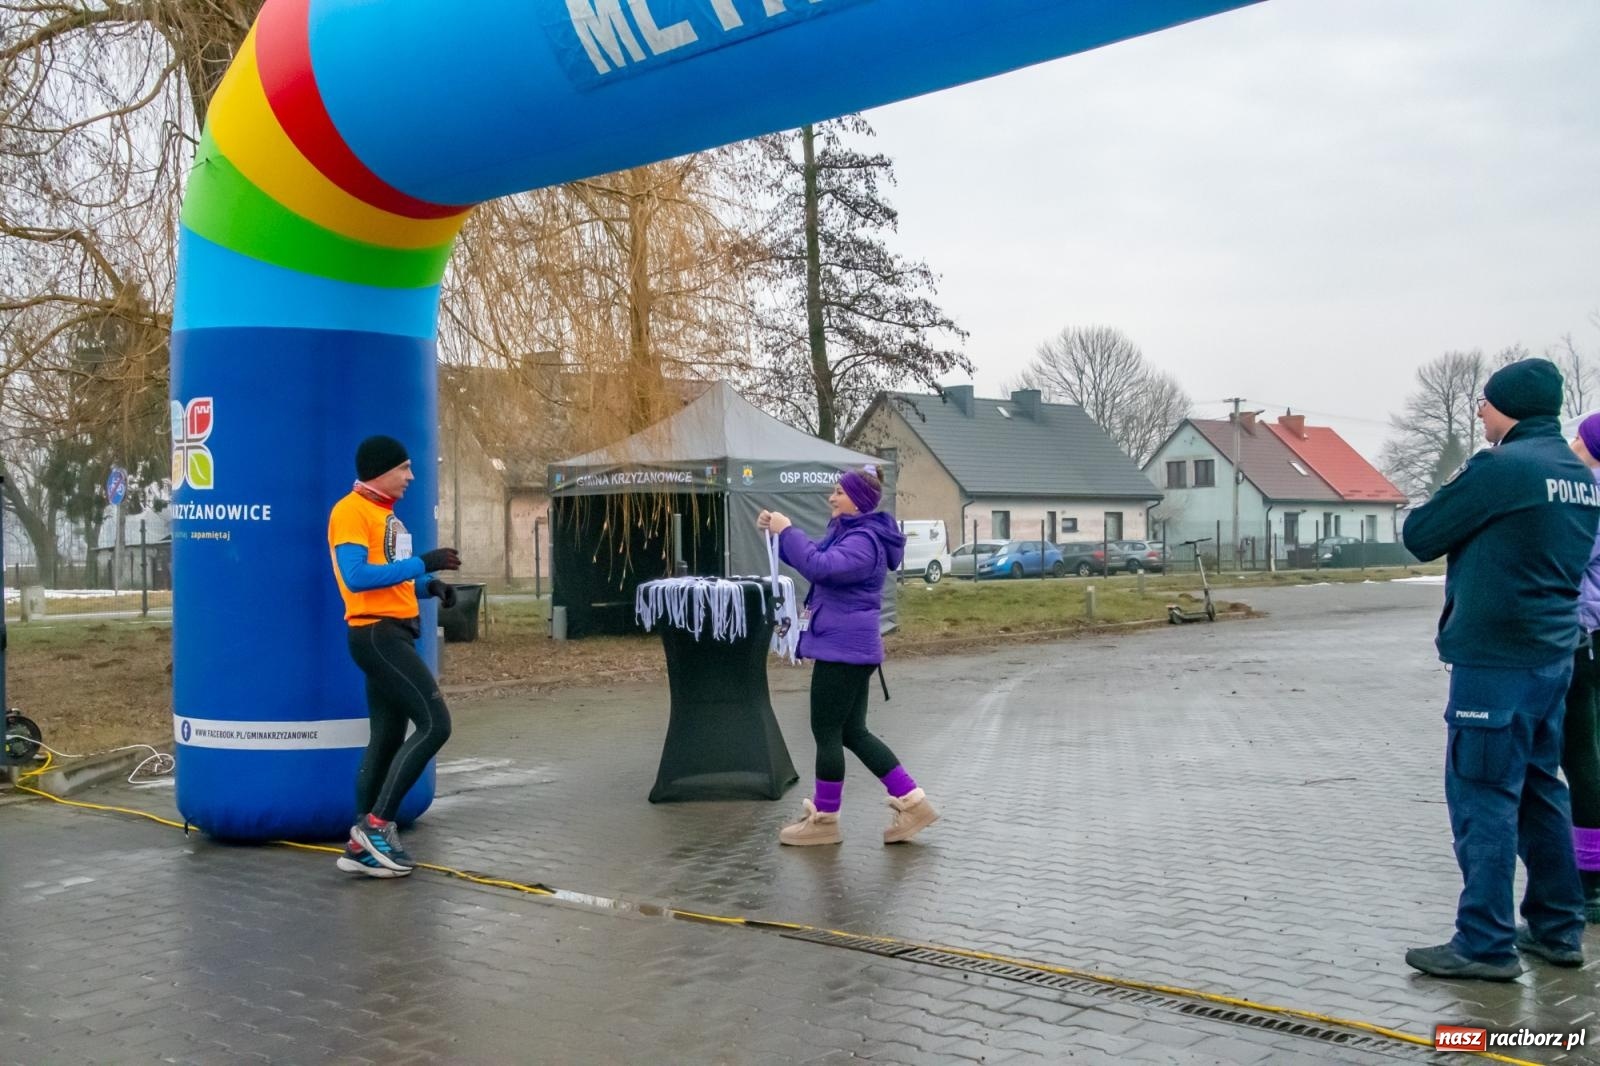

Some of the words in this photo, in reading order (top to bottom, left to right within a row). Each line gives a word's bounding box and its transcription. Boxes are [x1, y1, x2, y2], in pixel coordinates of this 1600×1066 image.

[780, 471, 800, 484] OSP
[802, 470, 844, 484] ROSZKÓ
[171, 500, 272, 521] RZYŻANOWICE
